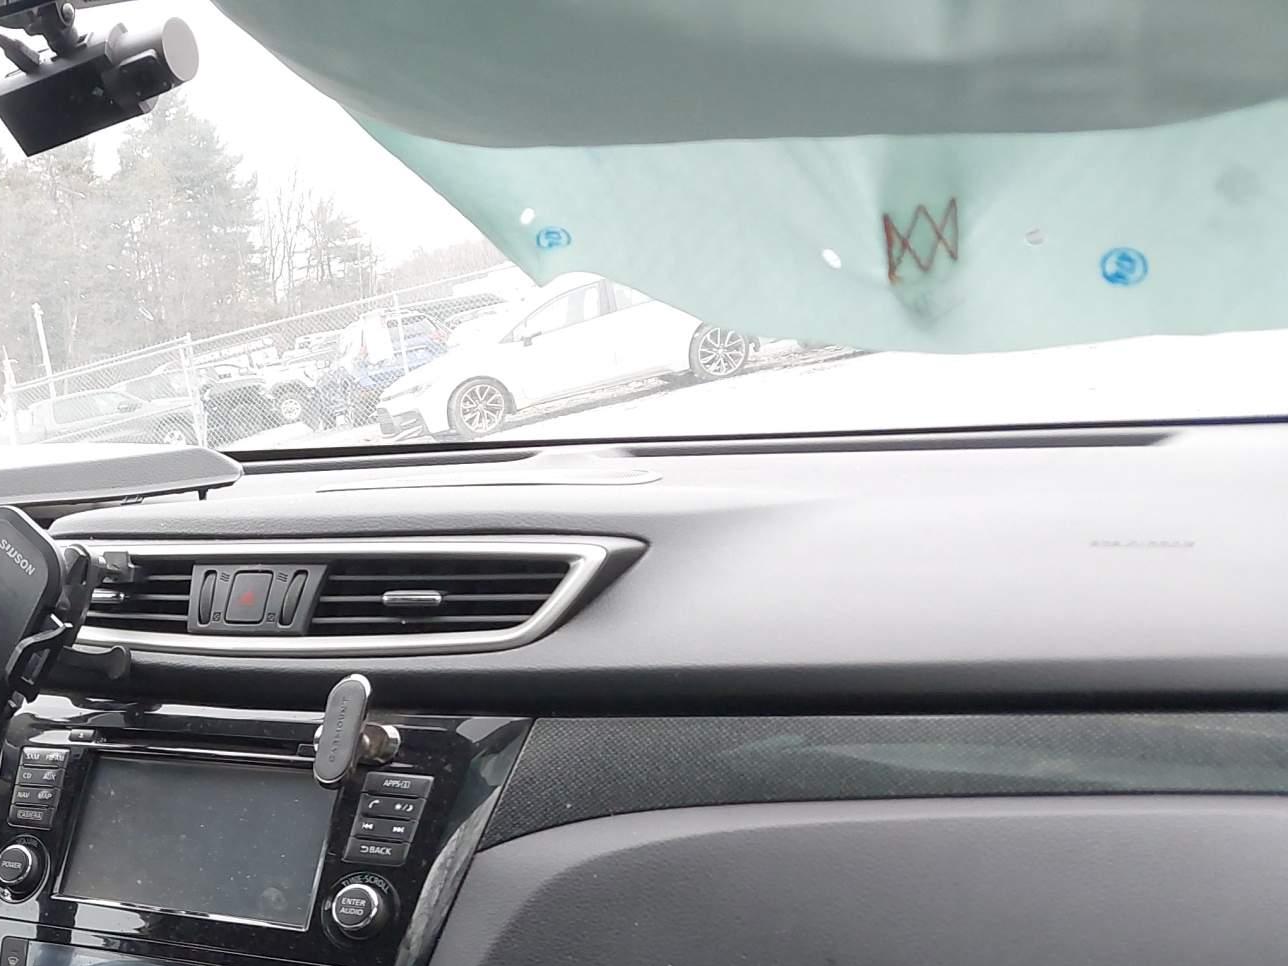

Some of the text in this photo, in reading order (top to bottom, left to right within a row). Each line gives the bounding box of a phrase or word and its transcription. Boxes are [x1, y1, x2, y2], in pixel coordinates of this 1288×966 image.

[369, 845, 392, 856] BACK
[341, 897, 366, 906] ENTER
[340, 907, 364, 916] AUDIO
